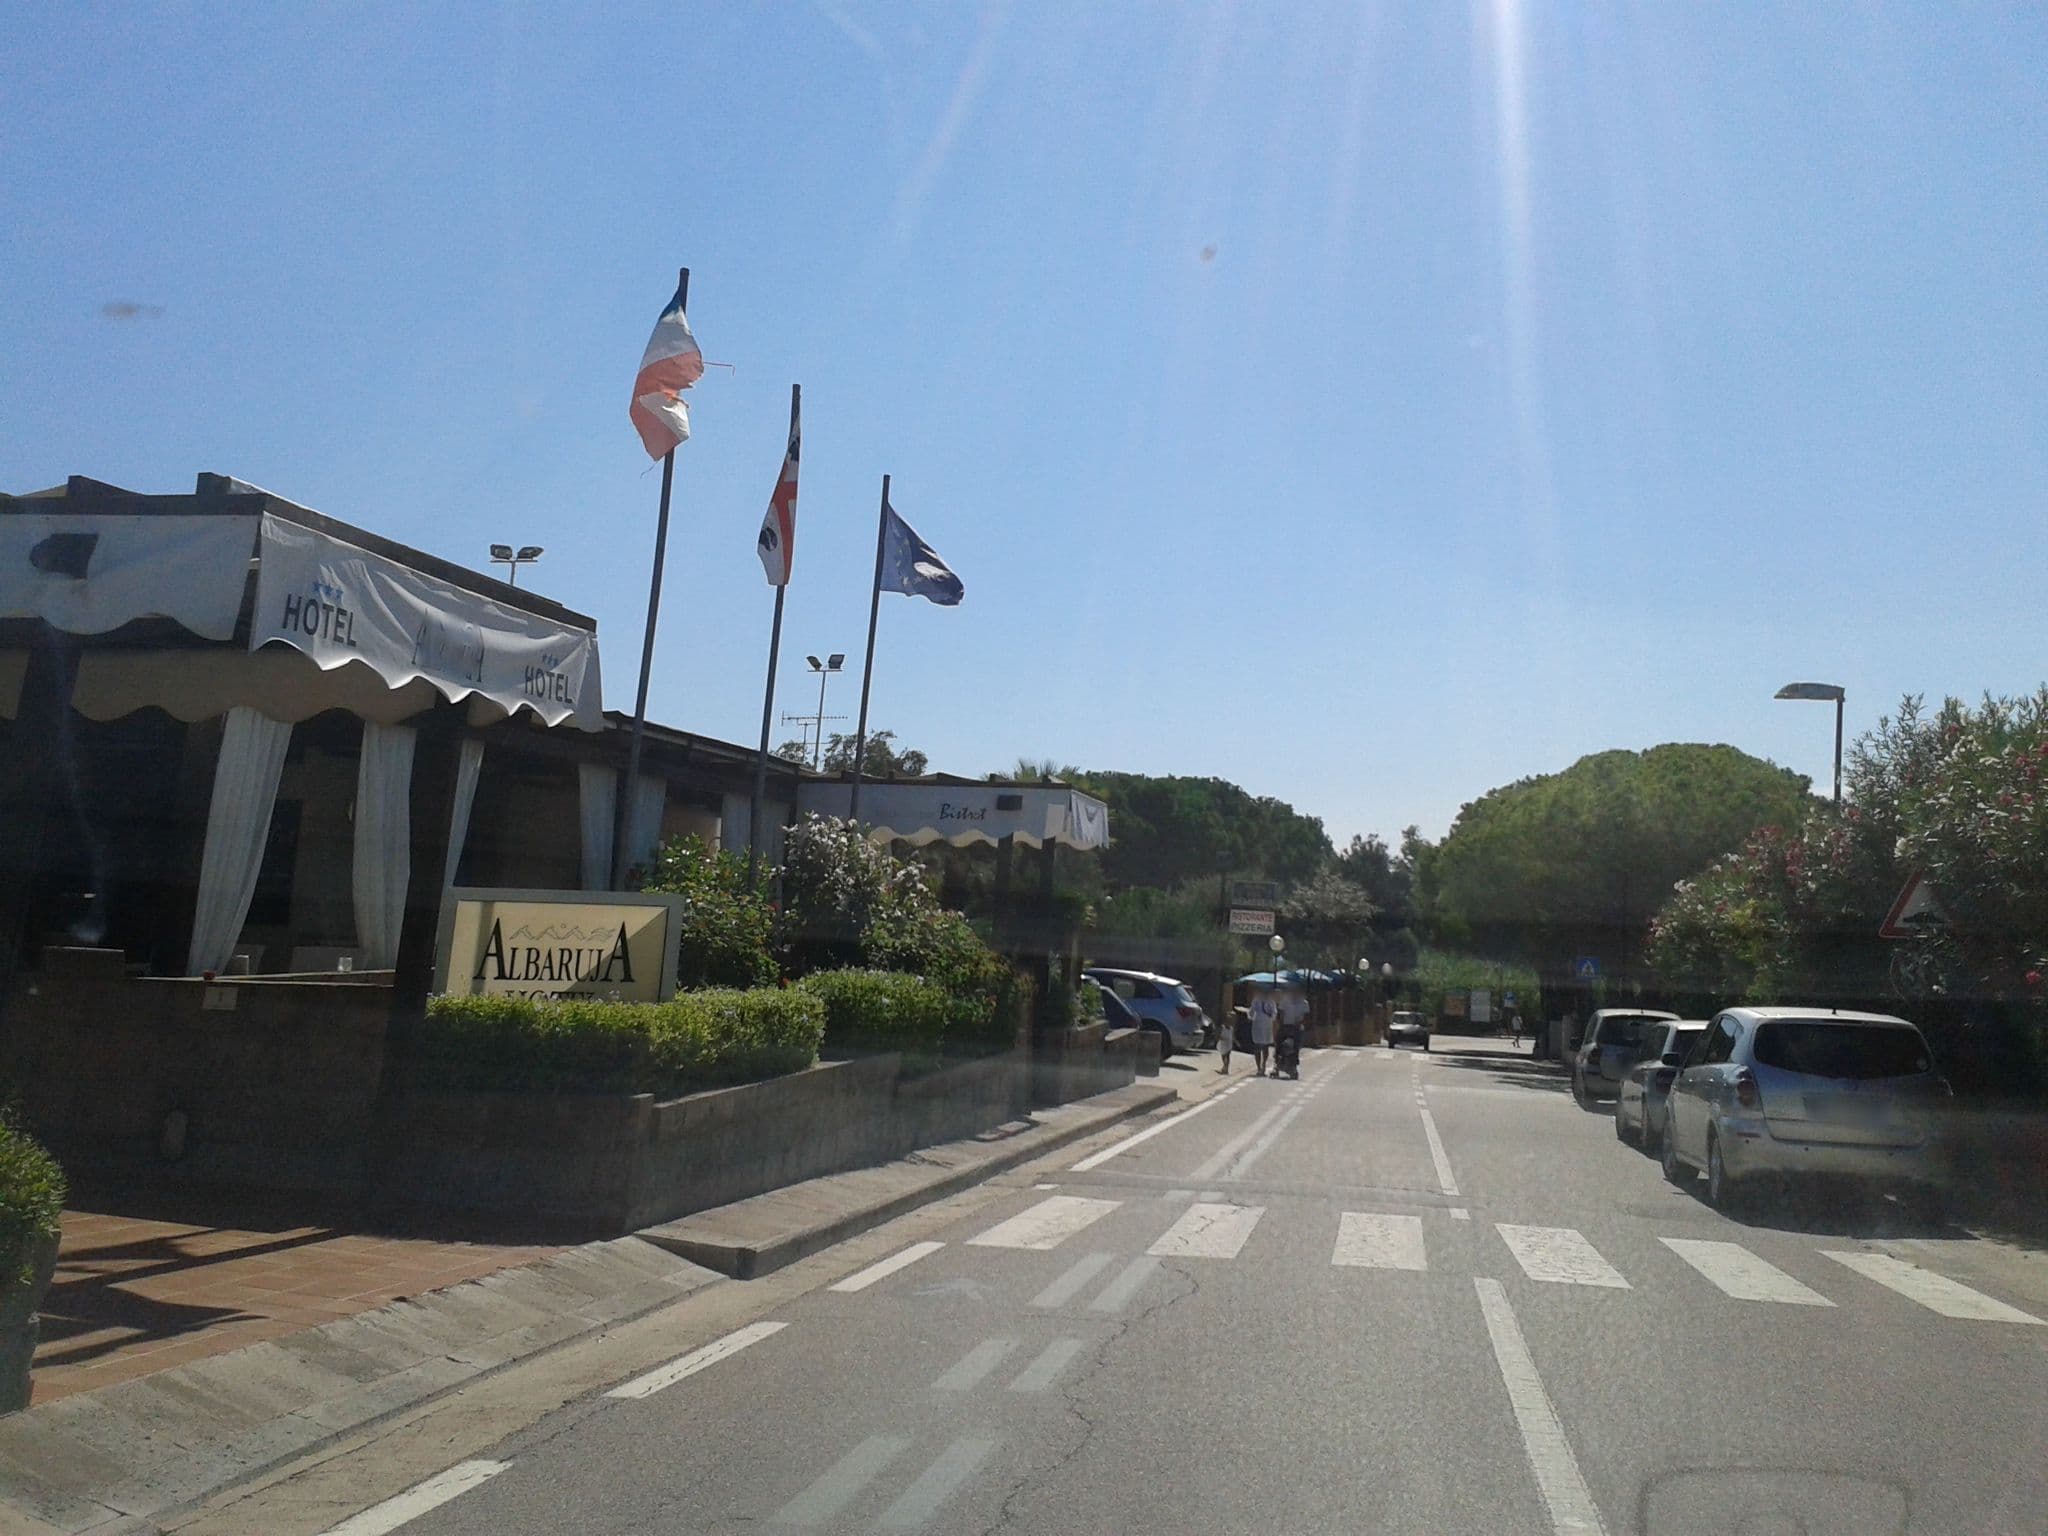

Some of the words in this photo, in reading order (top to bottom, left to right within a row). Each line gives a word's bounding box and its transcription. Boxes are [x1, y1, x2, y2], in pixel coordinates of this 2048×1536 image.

[282, 592, 357, 648] HOTEL
[524, 665, 573, 704] HOTEL
[472, 917, 635, 983] ALBARUJA
